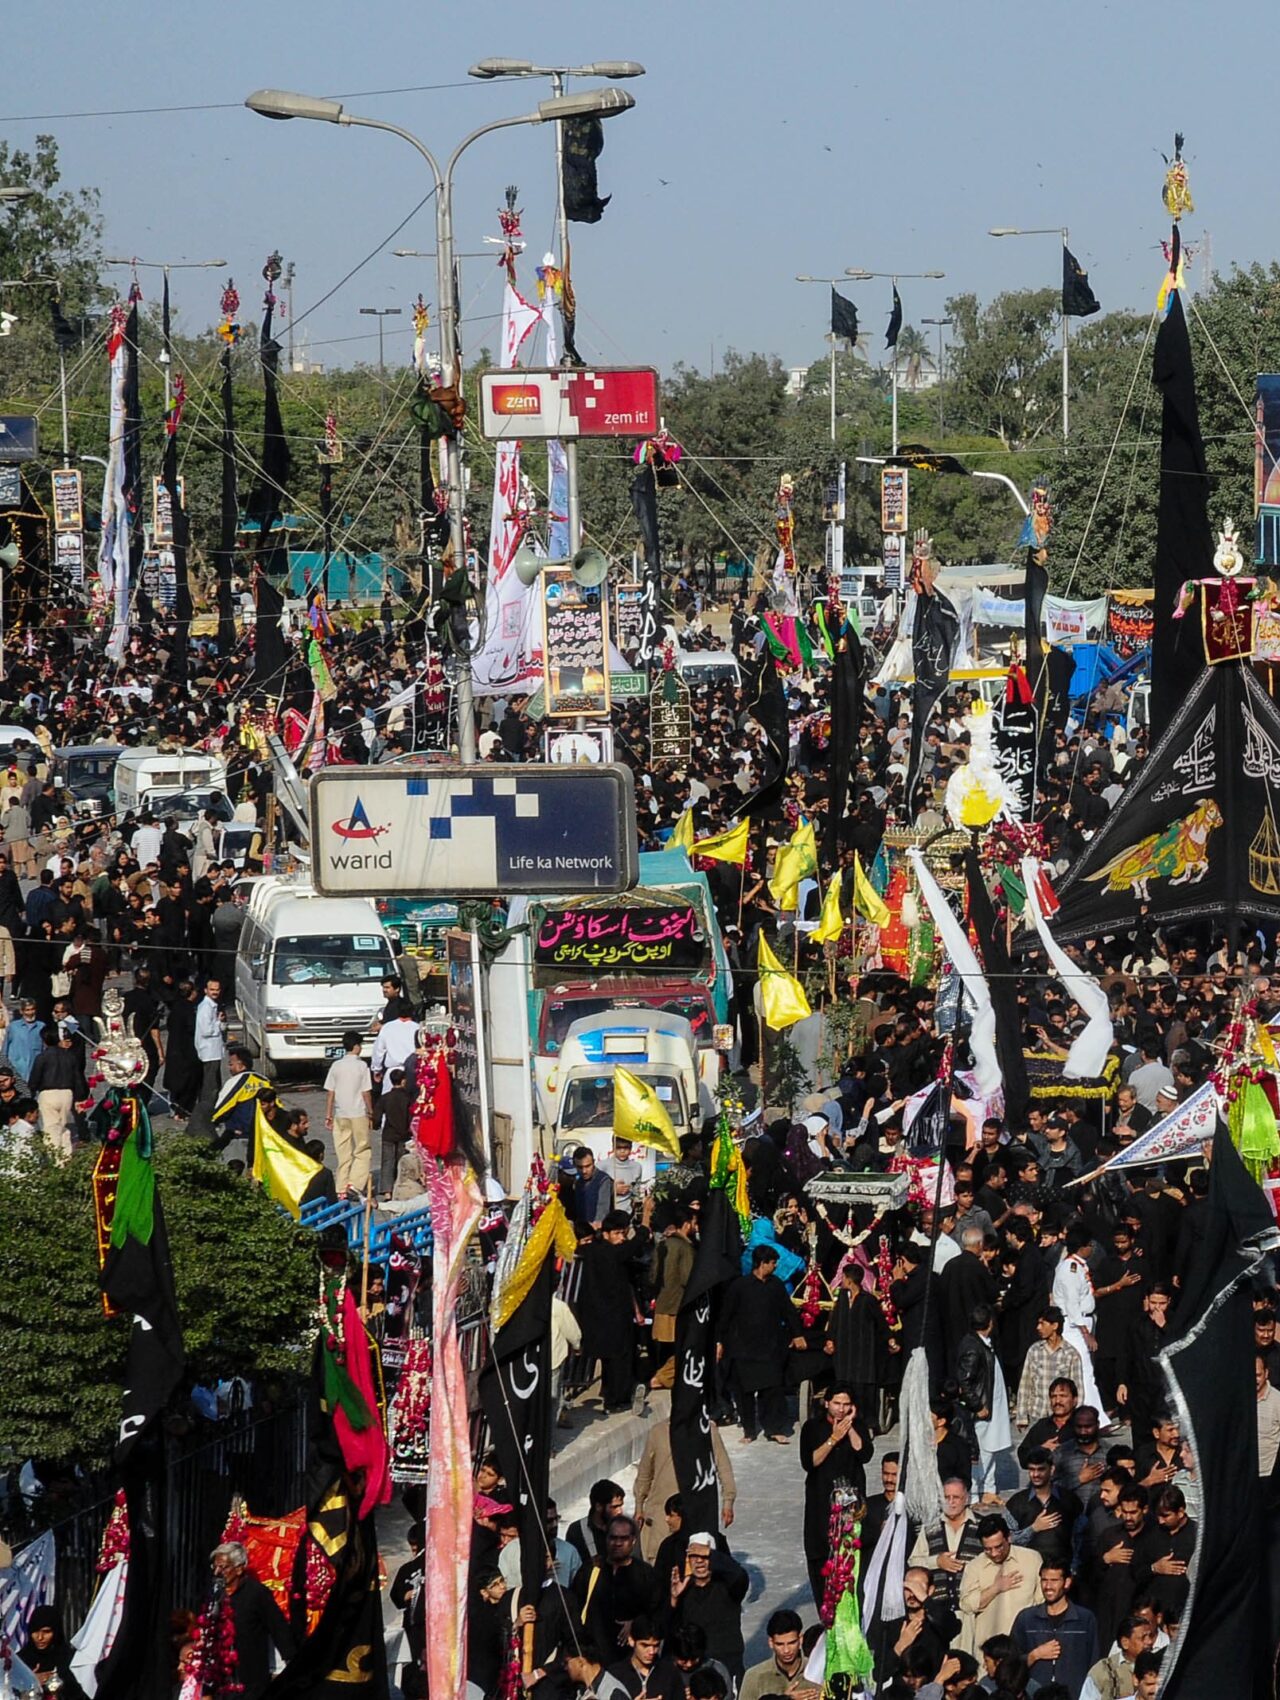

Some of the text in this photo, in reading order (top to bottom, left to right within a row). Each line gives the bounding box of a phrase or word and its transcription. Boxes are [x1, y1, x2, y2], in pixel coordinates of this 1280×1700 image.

[506, 396, 538, 408] zem
[604, 411, 649, 424] zem it!
[330, 850, 392, 870] warid
[509, 855, 613, 869] Life ka Network
